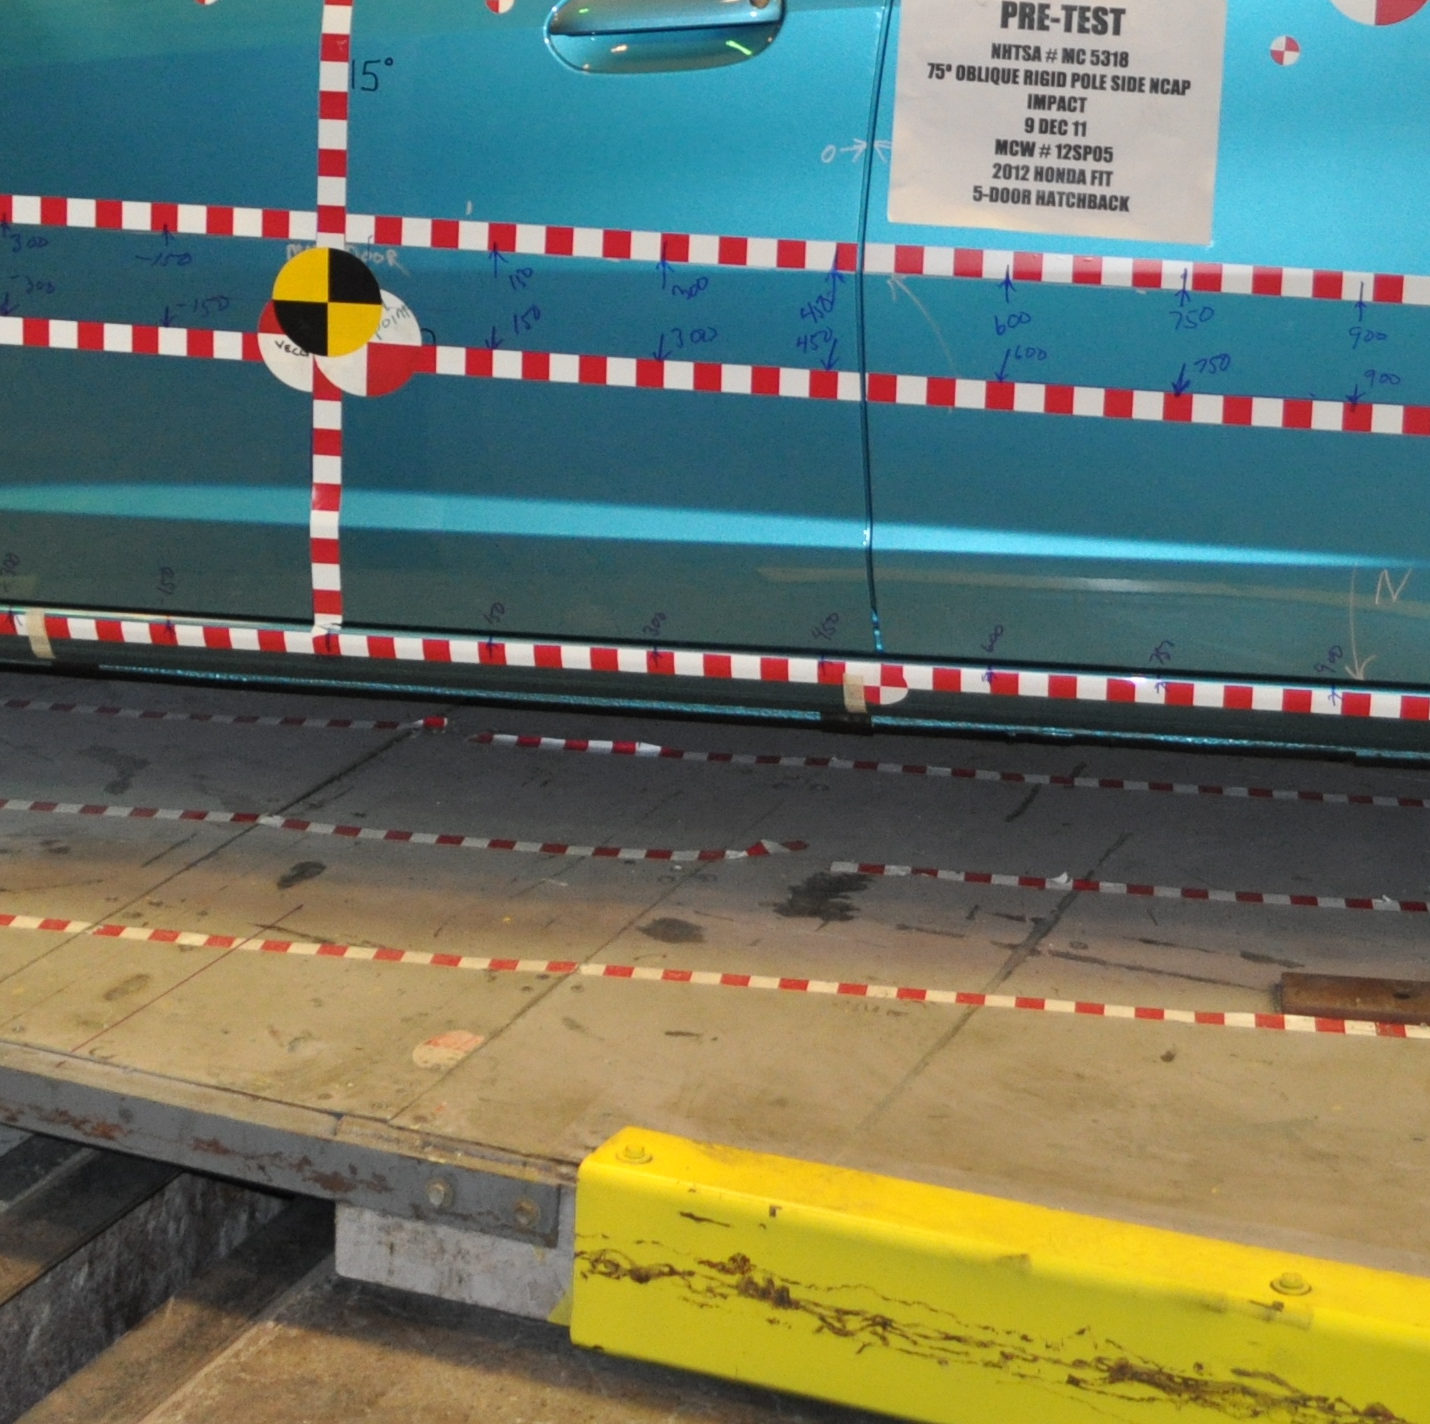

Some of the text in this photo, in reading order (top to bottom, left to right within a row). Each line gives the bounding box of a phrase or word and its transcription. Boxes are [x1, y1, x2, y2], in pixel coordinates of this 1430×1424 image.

[1000, 0, 1126, 36] PRE-TEST
[991, 43, 1129, 68] NHTSA # MC 5318
[955, 64, 1020, 87] OBLIQUE
[1023, 68, 1067, 89] RIGID
[1070, 72, 1107, 92] POLE
[1110, 74, 1145, 94] SIDE
[1149, 77, 1191, 96] NCAP
[1027, 94, 1088, 114] IMPACT
[1024, 117, 1087, 138] 9 DEC 11
[995, 138, 1114, 164] MCW # 12SP05
[992, 163, 1114, 187] 2012 HONDA FIT
[972, 185, 1130, 213] 5-DOOR HATCHBACK
[513, 304, 542, 335] 150
[994, 310, 1032, 337] 600
[1170, 306, 1215, 330] 750
[796, 327, 833, 355] 450
[1347, 325, 1388, 350] 900
[1014, 344, 1048, 362] 600
[1193, 352, 1231, 375] 750
[1362, 369, 1401, 387] 900
[483, 602, 505, 625] 150
[642, 611, 666, 636] 300
[811, 612, 839, 641] 450
[1313, 645, 1344, 674] 900
